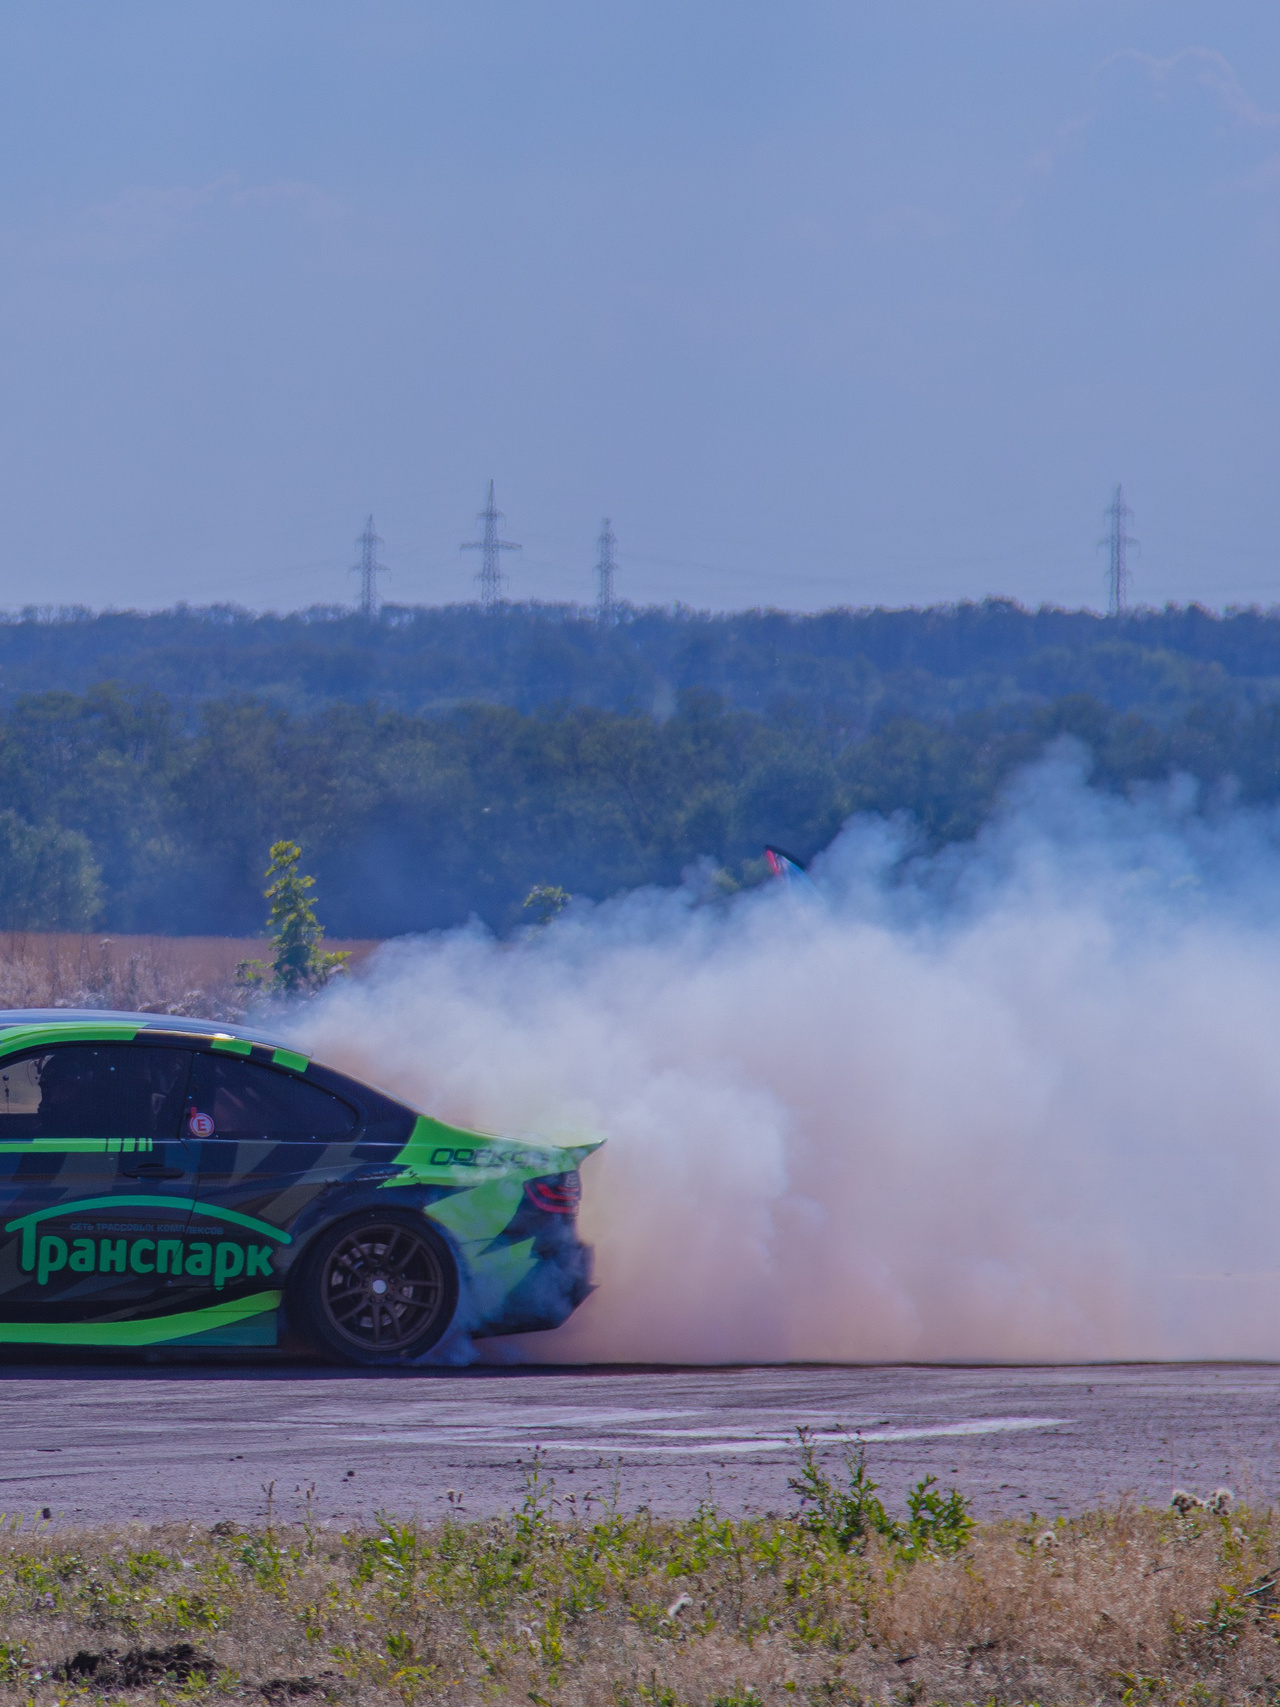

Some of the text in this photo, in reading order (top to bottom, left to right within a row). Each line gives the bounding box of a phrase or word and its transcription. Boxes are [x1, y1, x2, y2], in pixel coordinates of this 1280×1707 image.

[196, 1118, 207, 1131] E
[70, 1222, 94, 1231] СЕТЬ
[5, 1195, 292, 1291] Транспарк
